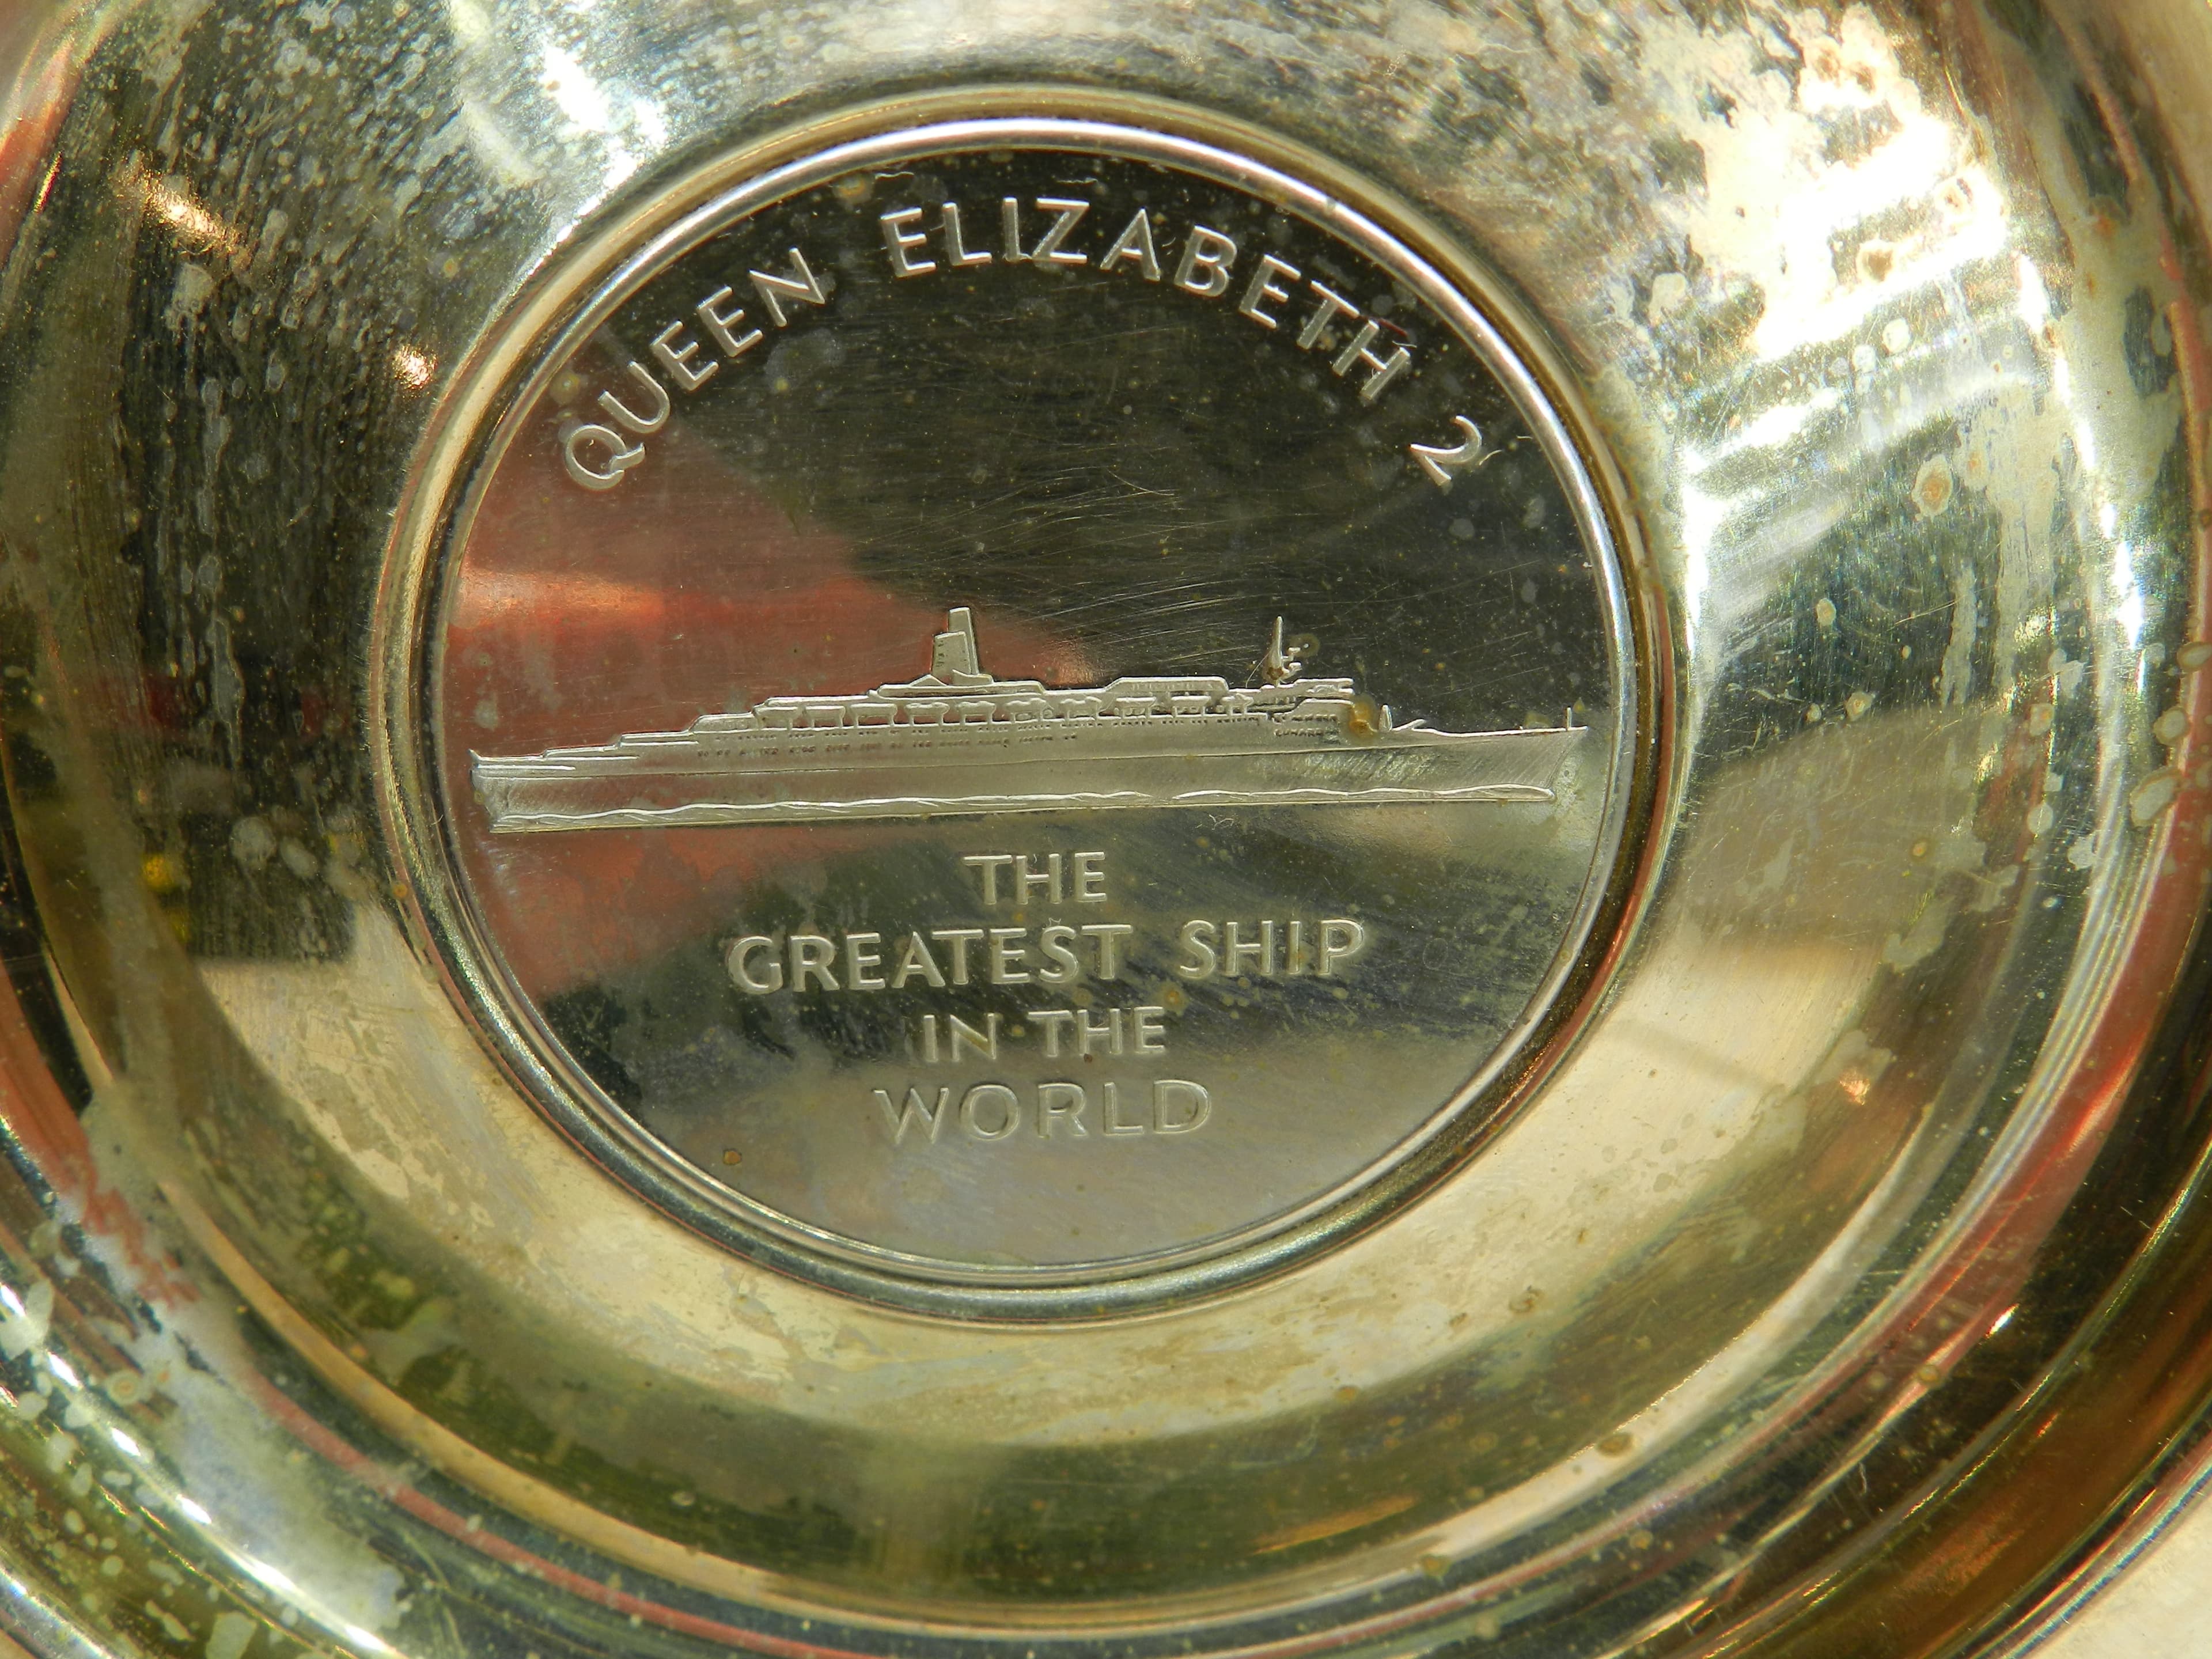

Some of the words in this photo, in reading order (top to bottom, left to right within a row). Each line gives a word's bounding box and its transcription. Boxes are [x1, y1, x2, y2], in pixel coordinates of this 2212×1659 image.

[564, 247, 825, 490] QUEEN
[880, 196, 1410, 400] ELIZABETH
[1410, 415, 1482, 486] 2
[963, 851, 1107, 906] THE
[726, 925, 1132, 994] GREATEST
[1179, 919, 1365, 979] SHIP
[922, 1014, 998, 1063] IN
[1028, 1005, 1168, 1057] THE
[874, 1078, 1212, 1145] WORLD
